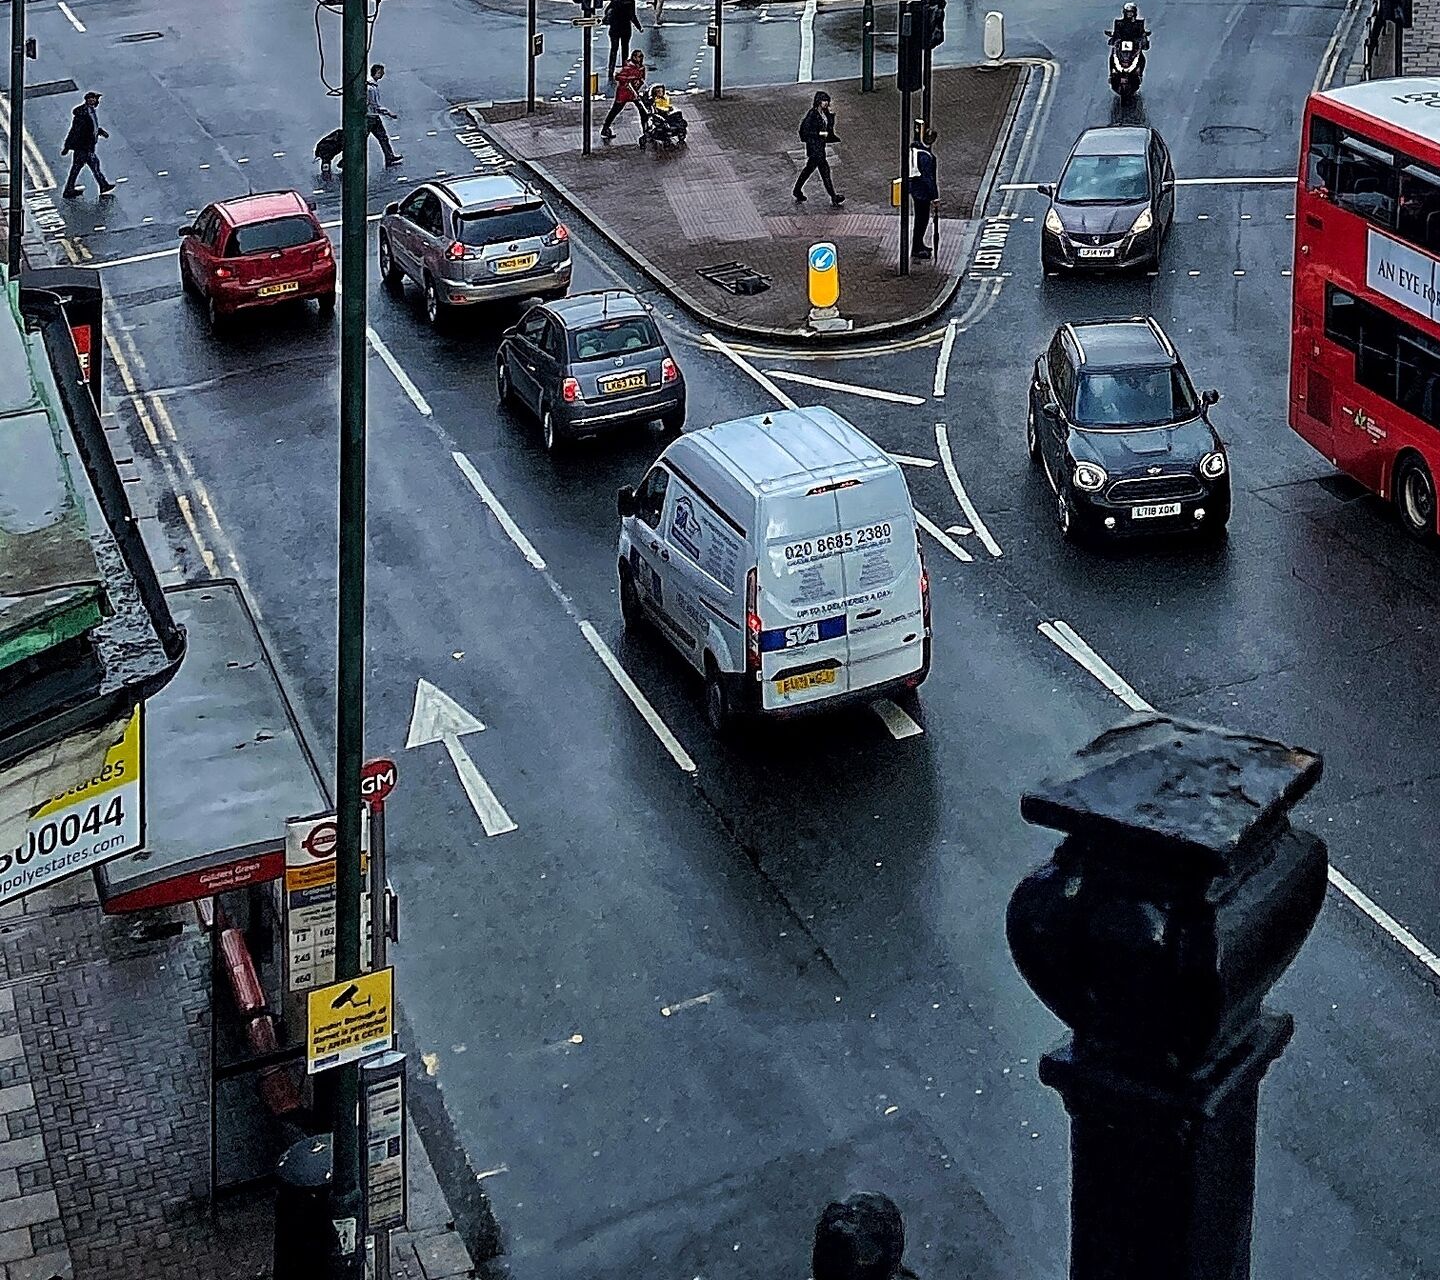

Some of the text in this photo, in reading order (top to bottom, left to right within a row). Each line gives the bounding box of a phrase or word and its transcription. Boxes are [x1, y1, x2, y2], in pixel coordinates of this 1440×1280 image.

[1377, 258, 1395, 283] AN
[1399, 267, 1420, 295] EYE
[785, 541, 813, 560] 020
[816, 532, 853, 553] 8685
[856, 523, 891, 544] 2380
[313, 1021, 342, 1035] London
[344, 1010, 377, 1026] Borough
[313, 1015, 388, 1045] Barnet is protected
[316, 1045, 327, 1055] by
[361, 1026, 384, 1040] CCTV
